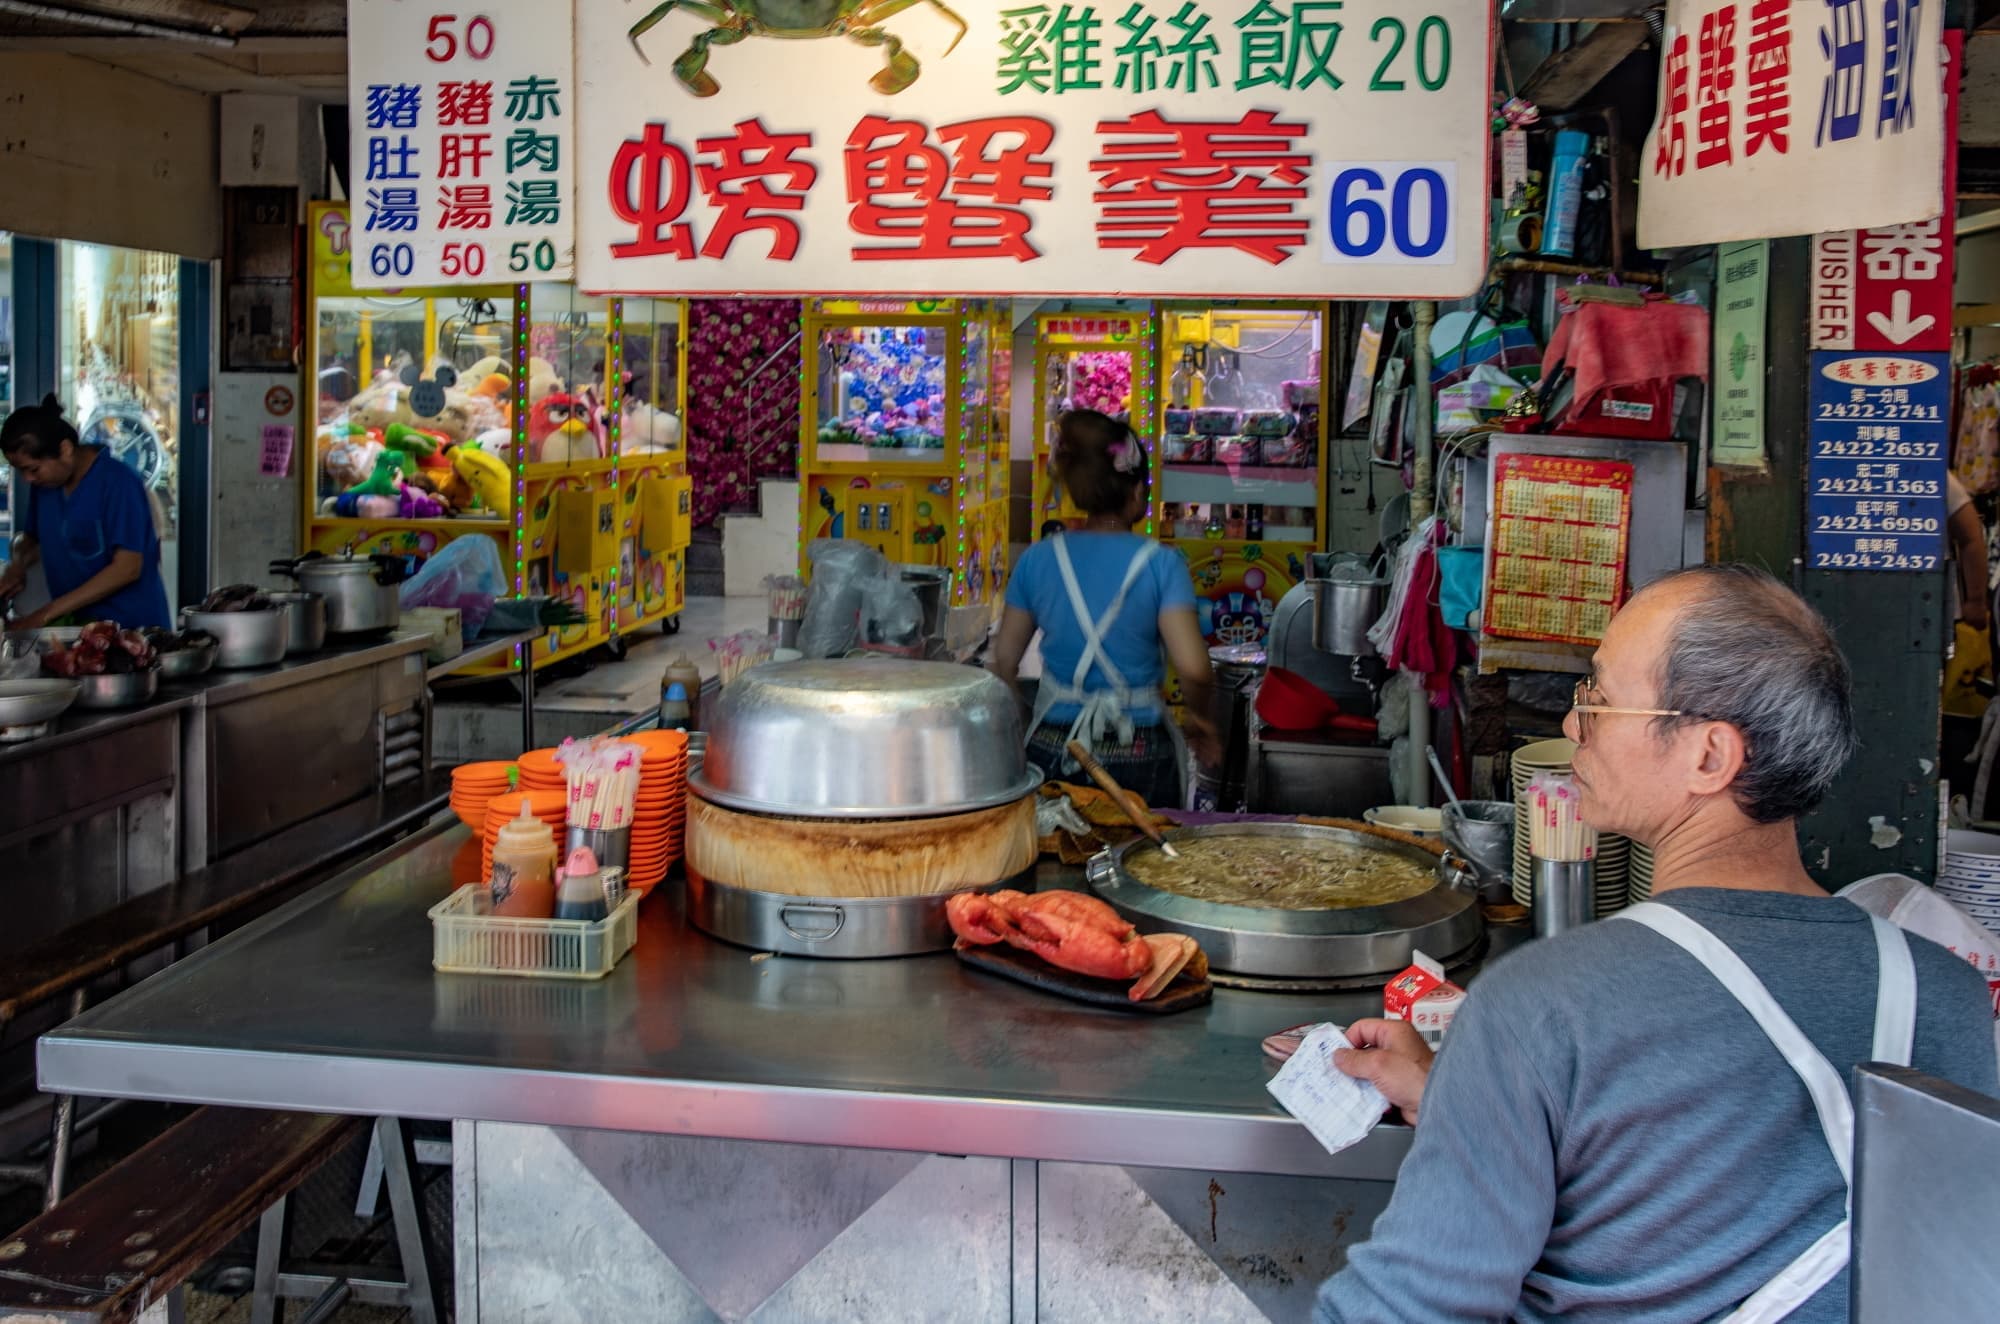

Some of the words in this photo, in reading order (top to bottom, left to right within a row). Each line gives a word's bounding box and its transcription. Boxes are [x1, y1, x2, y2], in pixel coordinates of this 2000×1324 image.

[427, 14, 496, 62] 50
[996, 0, 1344, 95] 雞絲飯
[1368, 15, 1451, 92] 20
[366, 83, 421, 232] 豬肚湯
[437, 80, 493, 231] 豬肝湯
[504, 75, 561, 226] 赤肉湯
[609, 109, 1312, 265] 螃蟹羹
[1329, 168, 1448, 258] 60
[370, 243, 414, 277] 60
[440, 242, 486, 277] 50
[509, 239, 555, 272] 50
[1819, 230, 1848, 341] UISHER
[1819, 403, 1940, 418] 2422-2741
[1818, 440, 1940, 456] 2422-2637
[1817, 478, 1939, 494] 2424-1363
[1817, 515, 1939, 532] 2424-6950
[1816, 552, 1937, 569] 2424-2437
